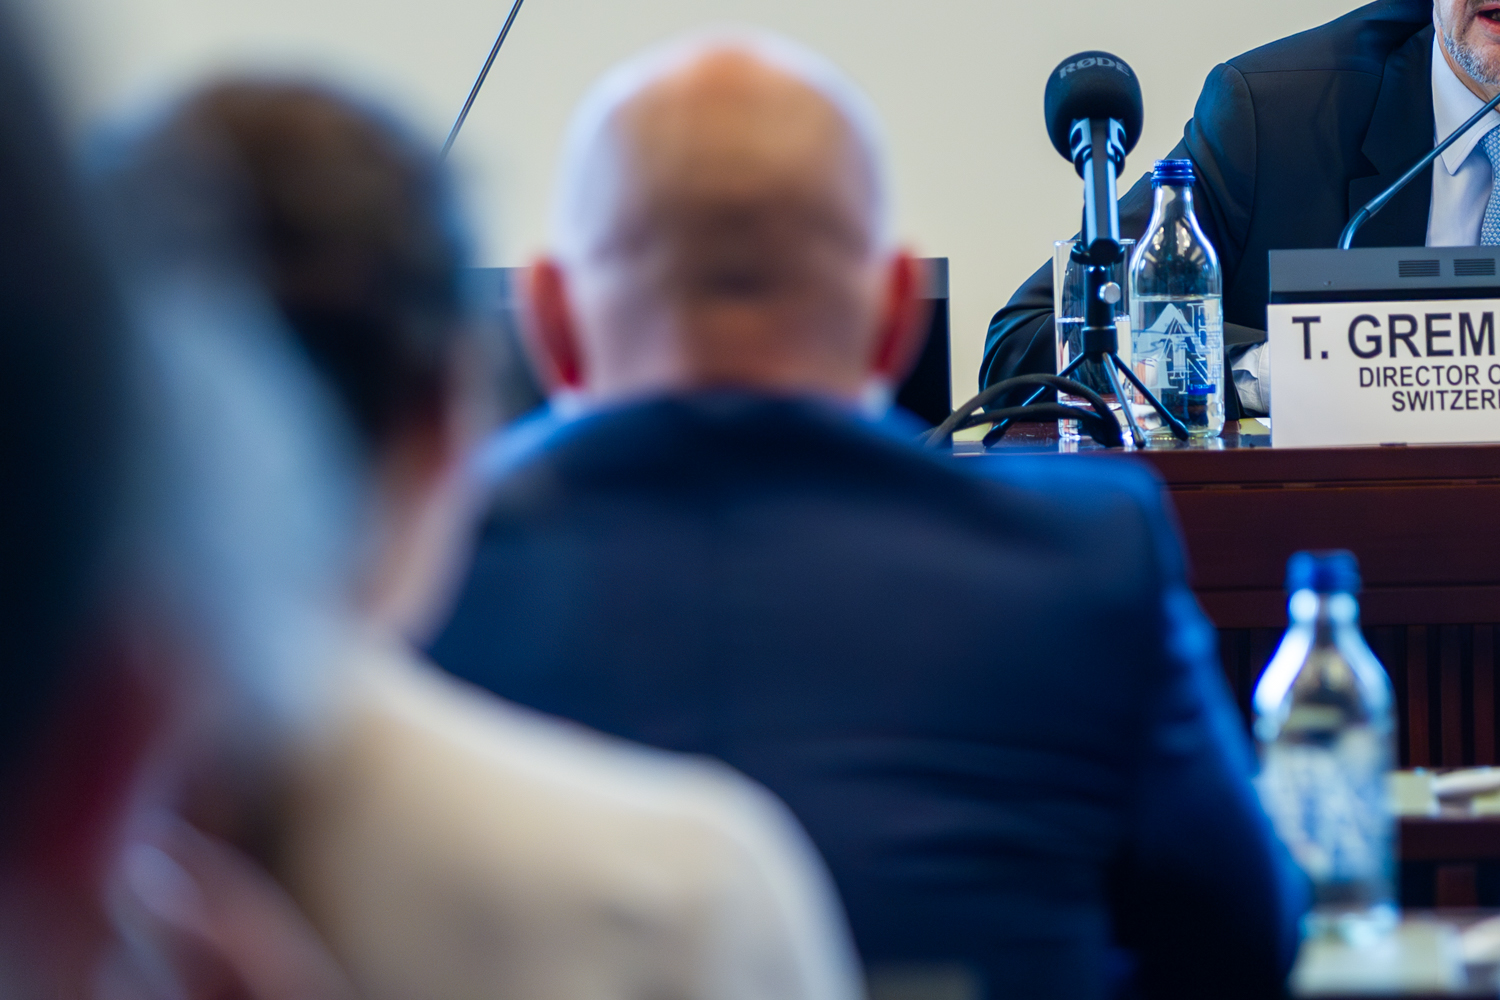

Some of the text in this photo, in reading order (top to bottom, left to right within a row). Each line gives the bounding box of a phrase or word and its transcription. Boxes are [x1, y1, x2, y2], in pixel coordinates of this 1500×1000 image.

[1059, 56, 1130, 79] RØDE
[1291, 315, 1330, 360] T.
[1359, 364, 1480, 388] DIRECTOR
